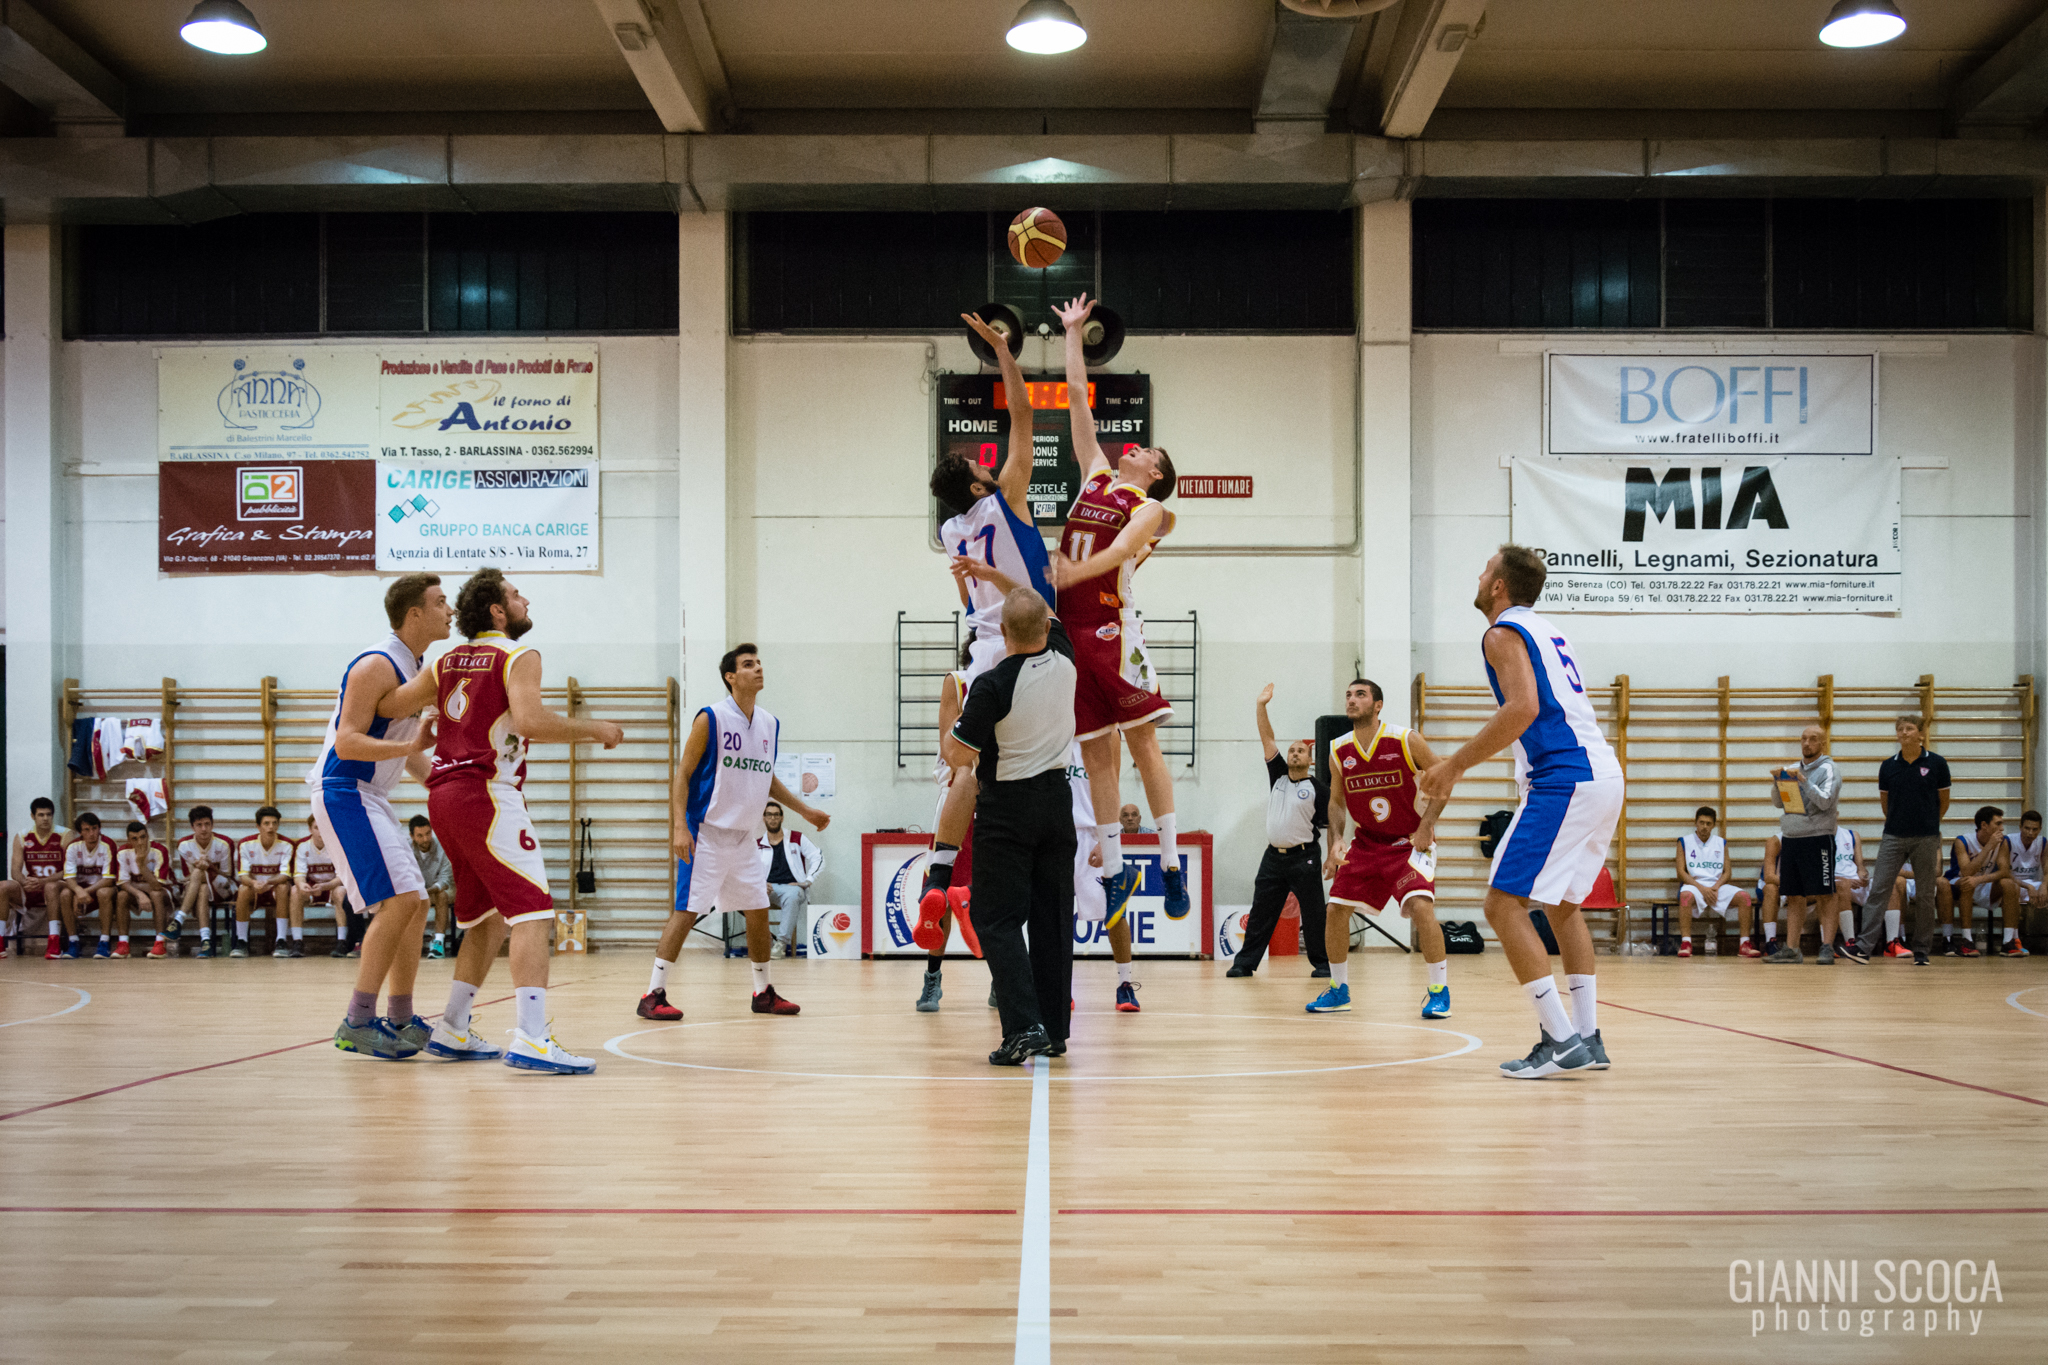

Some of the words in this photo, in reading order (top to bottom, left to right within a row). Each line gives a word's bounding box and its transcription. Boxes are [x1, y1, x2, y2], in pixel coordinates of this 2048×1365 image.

[432, 363, 438, 374] e
[474, 359, 484, 374] di
[485, 359, 508, 374] Pane
[509, 362, 515, 374] e
[566, 359, 593, 374] Forno
[233, 378, 306, 408] ANNA
[493, 396, 506, 406] il
[510, 396, 551, 408] forno
[556, 395, 571, 406] di
[1620, 366, 1808, 424] BOFFI
[239, 410, 301, 418] PASTICCERIA
[438, 402, 571, 431] Antonio
[948, 420, 998, 433] HOME
[226, 434, 235, 443] di
[237, 434, 274, 442] Balestrini
[276, 434, 312, 442] Marcello
[1635, 432, 1779, 444] www.fratelliboffi.it
[381, 447, 397, 457] Via
[400, 446, 408, 456] T.
[411, 446, 442, 458] Tasso,
[445, 446, 450, 456] 2
[459, 446, 523, 456] BARLASSINA
[532, 445, 594, 456] 0362.562994
[387, 470, 472, 489] CARIGE
[476, 470, 588, 488] ASSICURAZIONI
[1027, 482, 1068, 494] ERTELÈ
[1180, 479, 1214, 494] VIETATO
[1218, 479, 1251, 494] FUMARE
[1622, 466, 1790, 542] MIA
[166, 525, 245, 547] Grafica
[251, 529, 272, 540] &
[279, 525, 373, 547] Stampa
[420, 524, 478, 537] GRUPPO
[482, 523, 532, 536] BANCA
[536, 523, 589, 536] CARIGE
[387, 547, 430, 561] Agenzia
[433, 546, 443, 558] di
[446, 546, 486, 558] Lentate
[489, 546, 507, 558] S/S
[517, 546, 535, 558] Via
[538, 546, 573, 559] Roma,
[576, 546, 588, 557] 27
[1069, 530, 1096, 562] 11
[1634, 550, 1735, 572] Legnami,
[1745, 549, 1878, 568] Sezionatura
[1544, 580, 1563, 589] gino
[1568, 580, 1603, 589] Serenza
[1606, 581, 1627, 590] (CO)
[1631, 581, 1646, 589] Tel.
[1650, 581, 1705, 589] 031.78.22.22
[1708, 581, 1723, 589] Fax
[1727, 581, 1781, 589] 031.78.22.21
[1785, 580, 1875, 589] www.mia-forniture.it
[1545, 593, 1563, 602] (VA)
[1566, 594, 1580, 602] Via
[1584, 594, 1614, 603] Europa
[1666, 594, 1722, 603] 031.78.22.22
[1725, 594, 1740, 602] Fax
[1744, 594, 1798, 602] 031.78.22.21
[1802, 594, 1893, 602] www.mia-forniture.it
[1550, 636, 1584, 693] 5
[444, 677, 472, 722] 6
[723, 732, 742, 751] 20
[733, 756, 772, 773] ASTECO
[1364, 775, 1399, 786] BOCCE
[1369, 796, 1391, 823] 9
[519, 828, 536, 851] 6
[1690, 849, 1696, 859] 4
[1696, 861, 1724, 869] ASTECO
[1821, 849, 1830, 886] EVINCE
[893, 868, 907, 911] Groane
[886, 902, 908, 944] Basket
